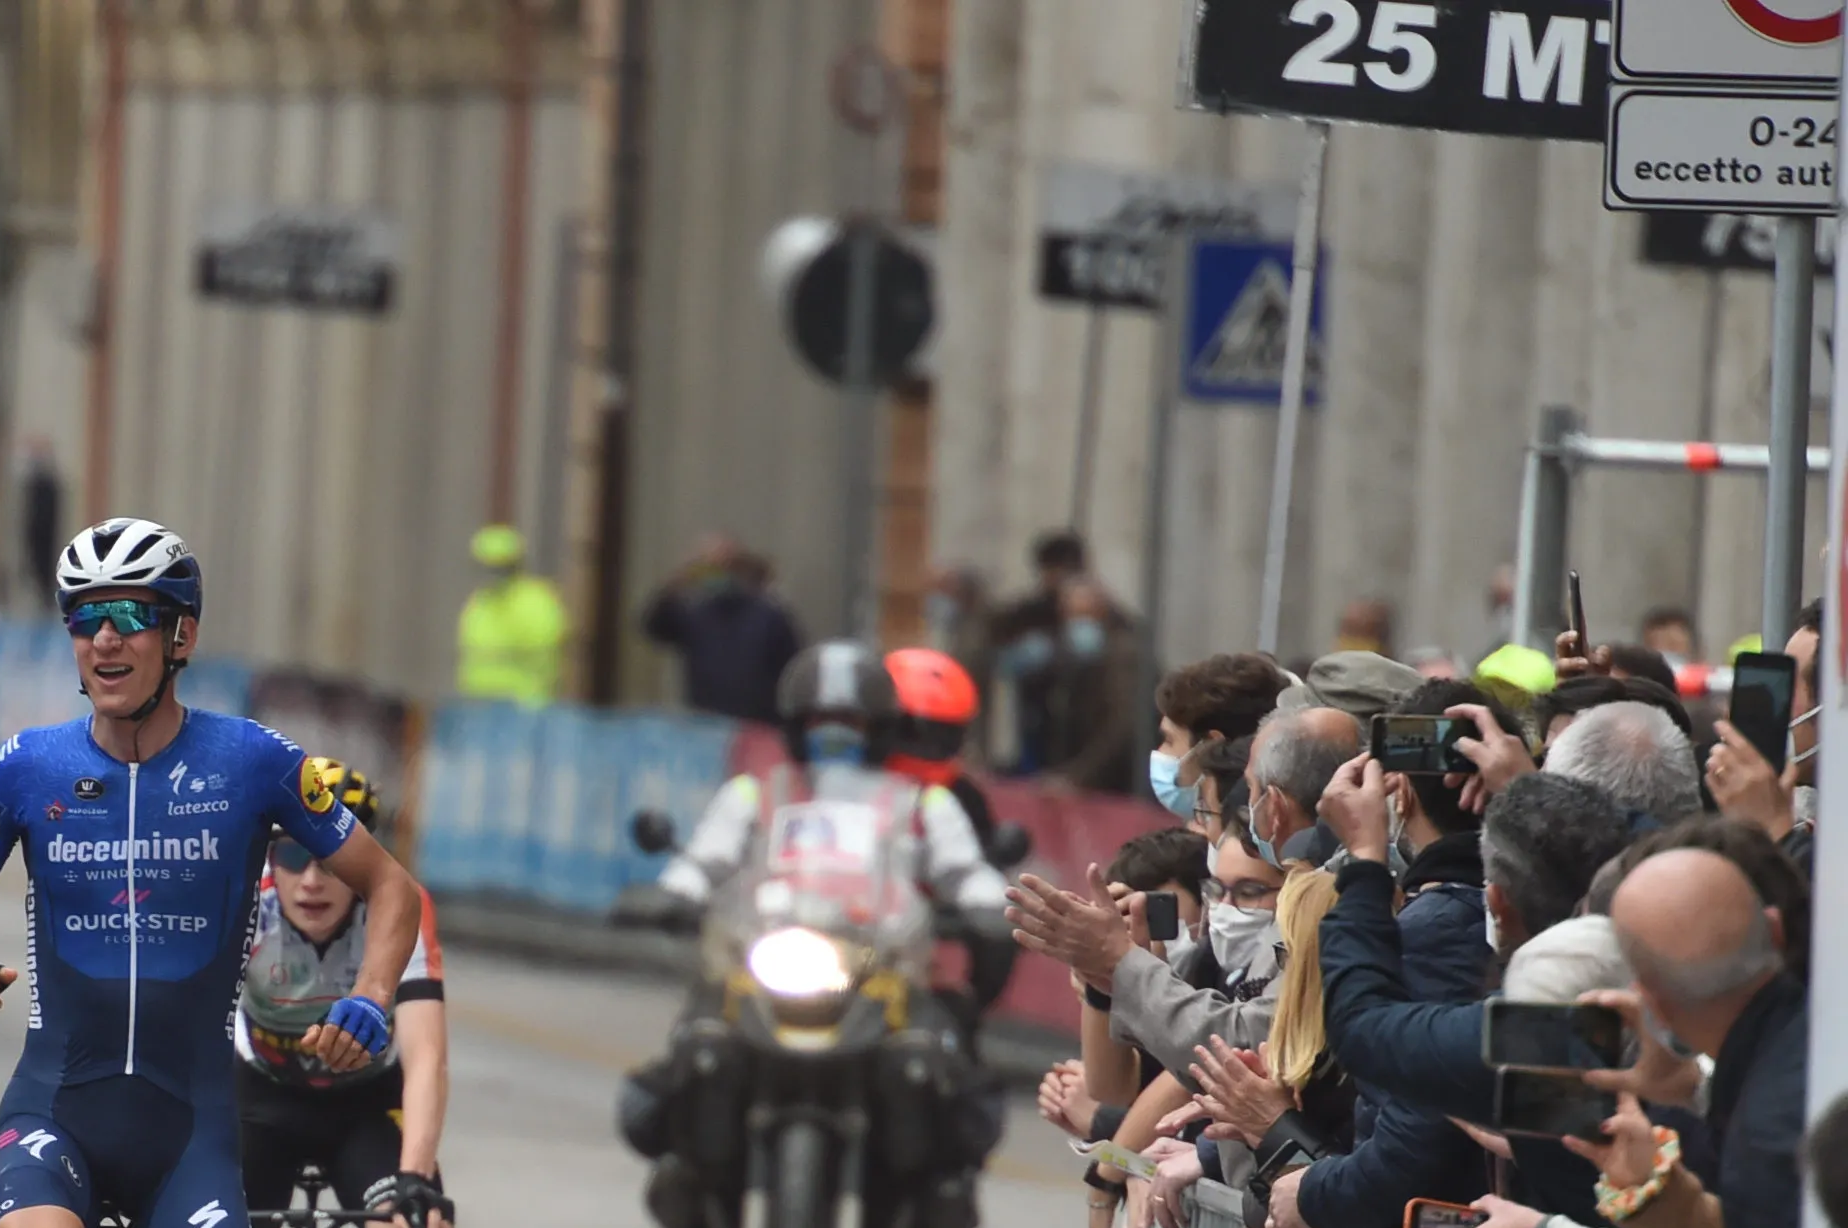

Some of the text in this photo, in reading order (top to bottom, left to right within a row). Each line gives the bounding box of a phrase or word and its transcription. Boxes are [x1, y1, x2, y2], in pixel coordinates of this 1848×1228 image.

[1281, 0, 1609, 106] 25 M
[1634, 157, 1762, 183] eccetto
[167, 800, 229, 816] latexco
[48, 829, 220, 863] deceuninck
[85, 868, 171, 881] WINDOWS
[104, 934, 166, 945] FLOORS
